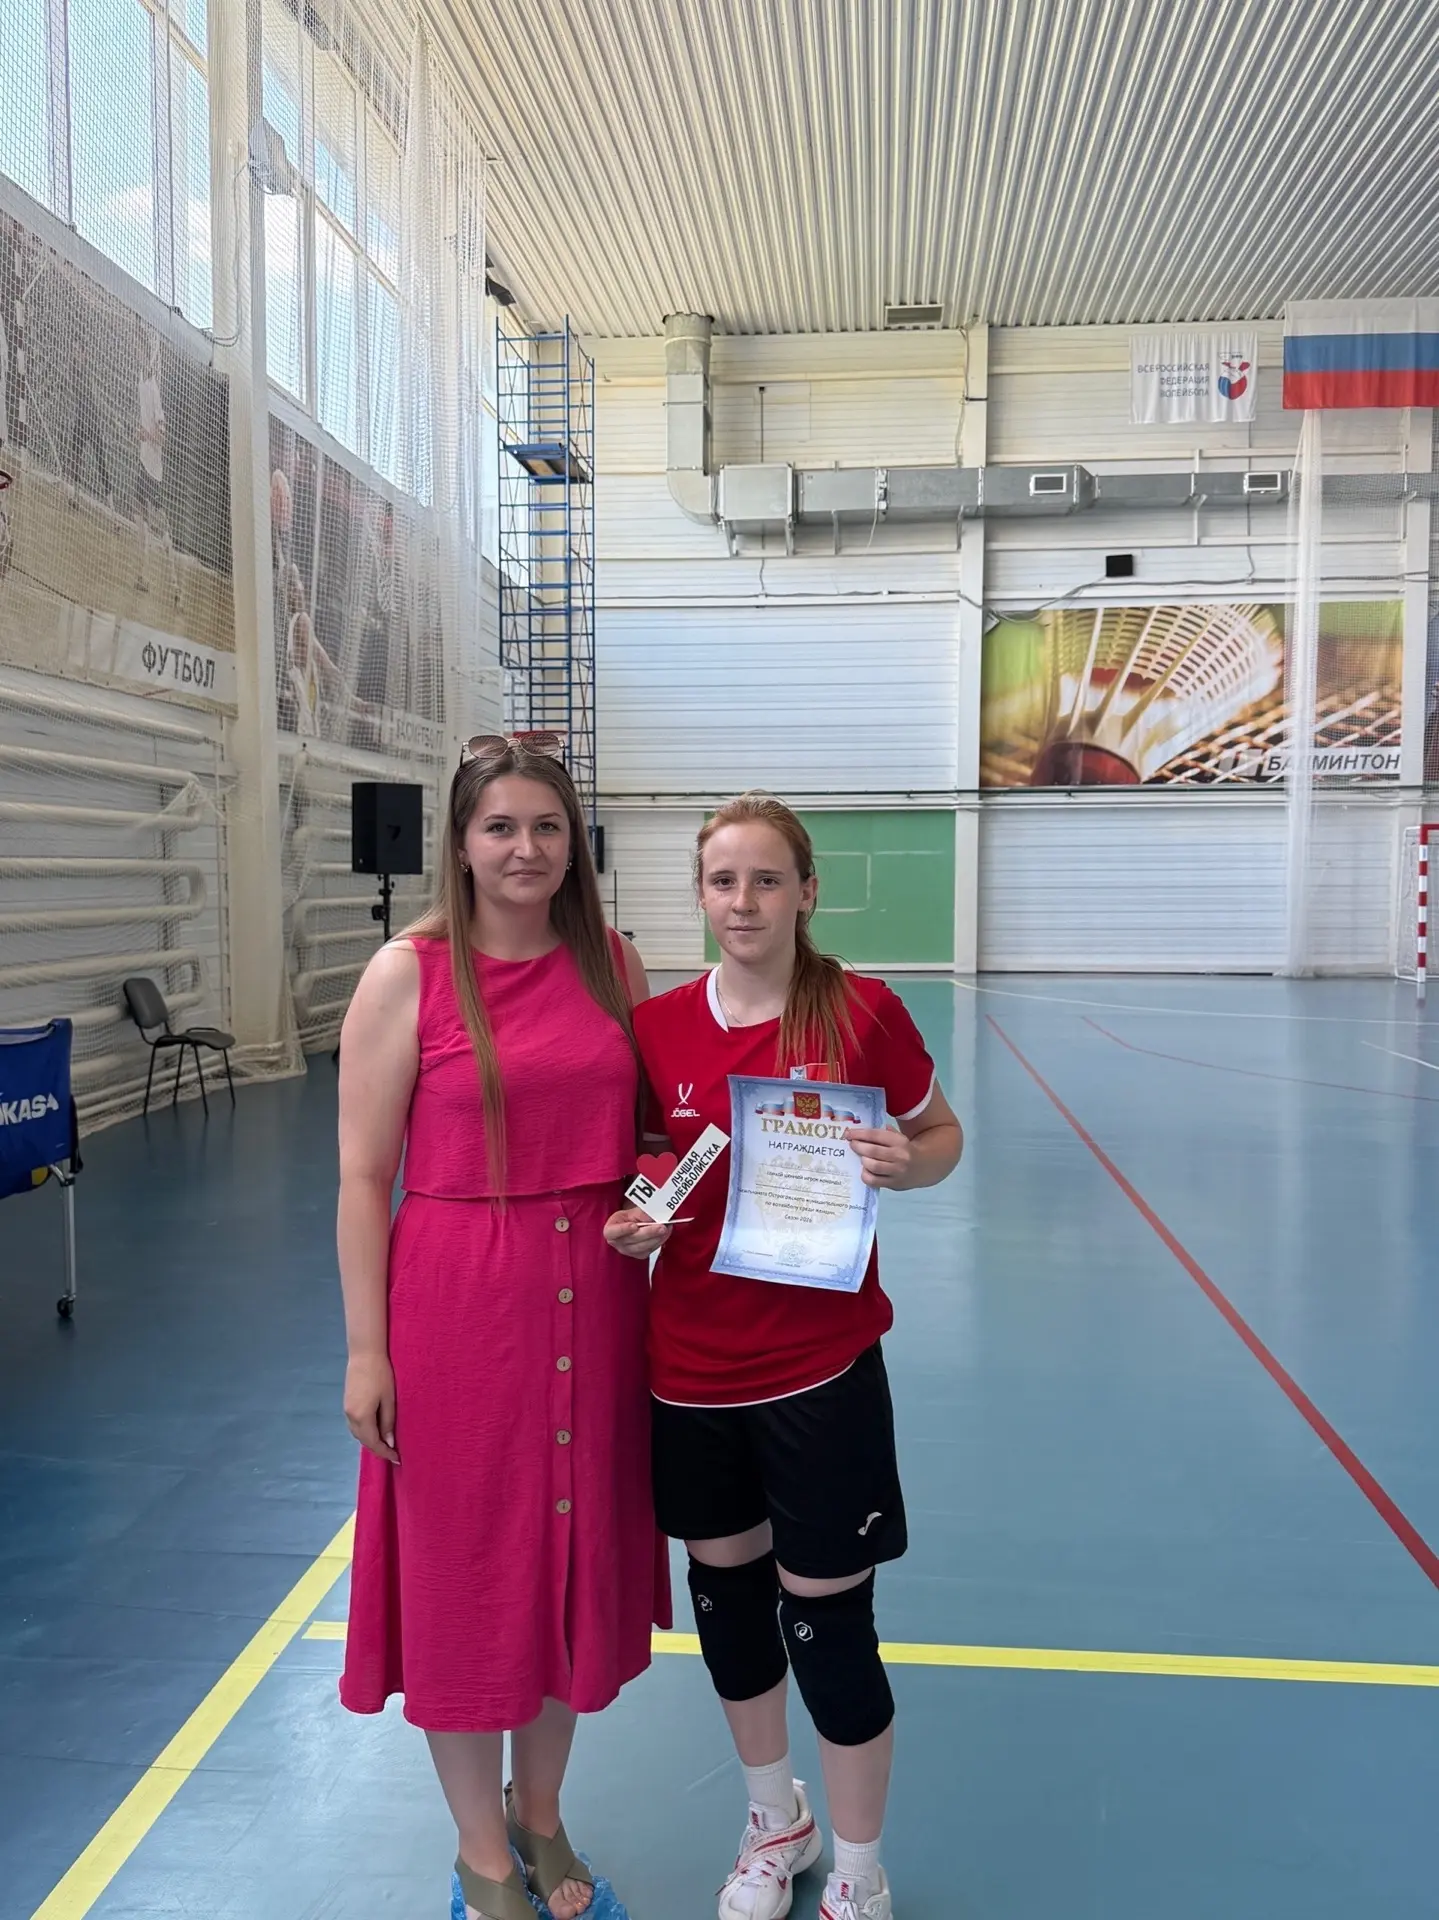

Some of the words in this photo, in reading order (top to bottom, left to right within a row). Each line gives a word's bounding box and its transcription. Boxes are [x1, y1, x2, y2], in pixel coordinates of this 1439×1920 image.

[1137, 362, 1210, 374] ВСЕРОССИЙСКАЯ
[1160, 375, 1210, 386] ФЕДЕРАЦИЯ
[1160, 387, 1210, 398] ВОЛЕЙБОЛА
[142, 640, 215, 689] ФУТБОЛ
[1267, 754, 1401, 771] БАМИНТОН
[768, 1140, 845, 1157] НАГРАЖДАЕТСЯ
[666, 1143, 721, 1211] ВОЛЕЙБОЛИСТКА
[671, 1151, 701, 1188] ЛУЧШАЯ
[628, 1177, 657, 1205] ТЫ
